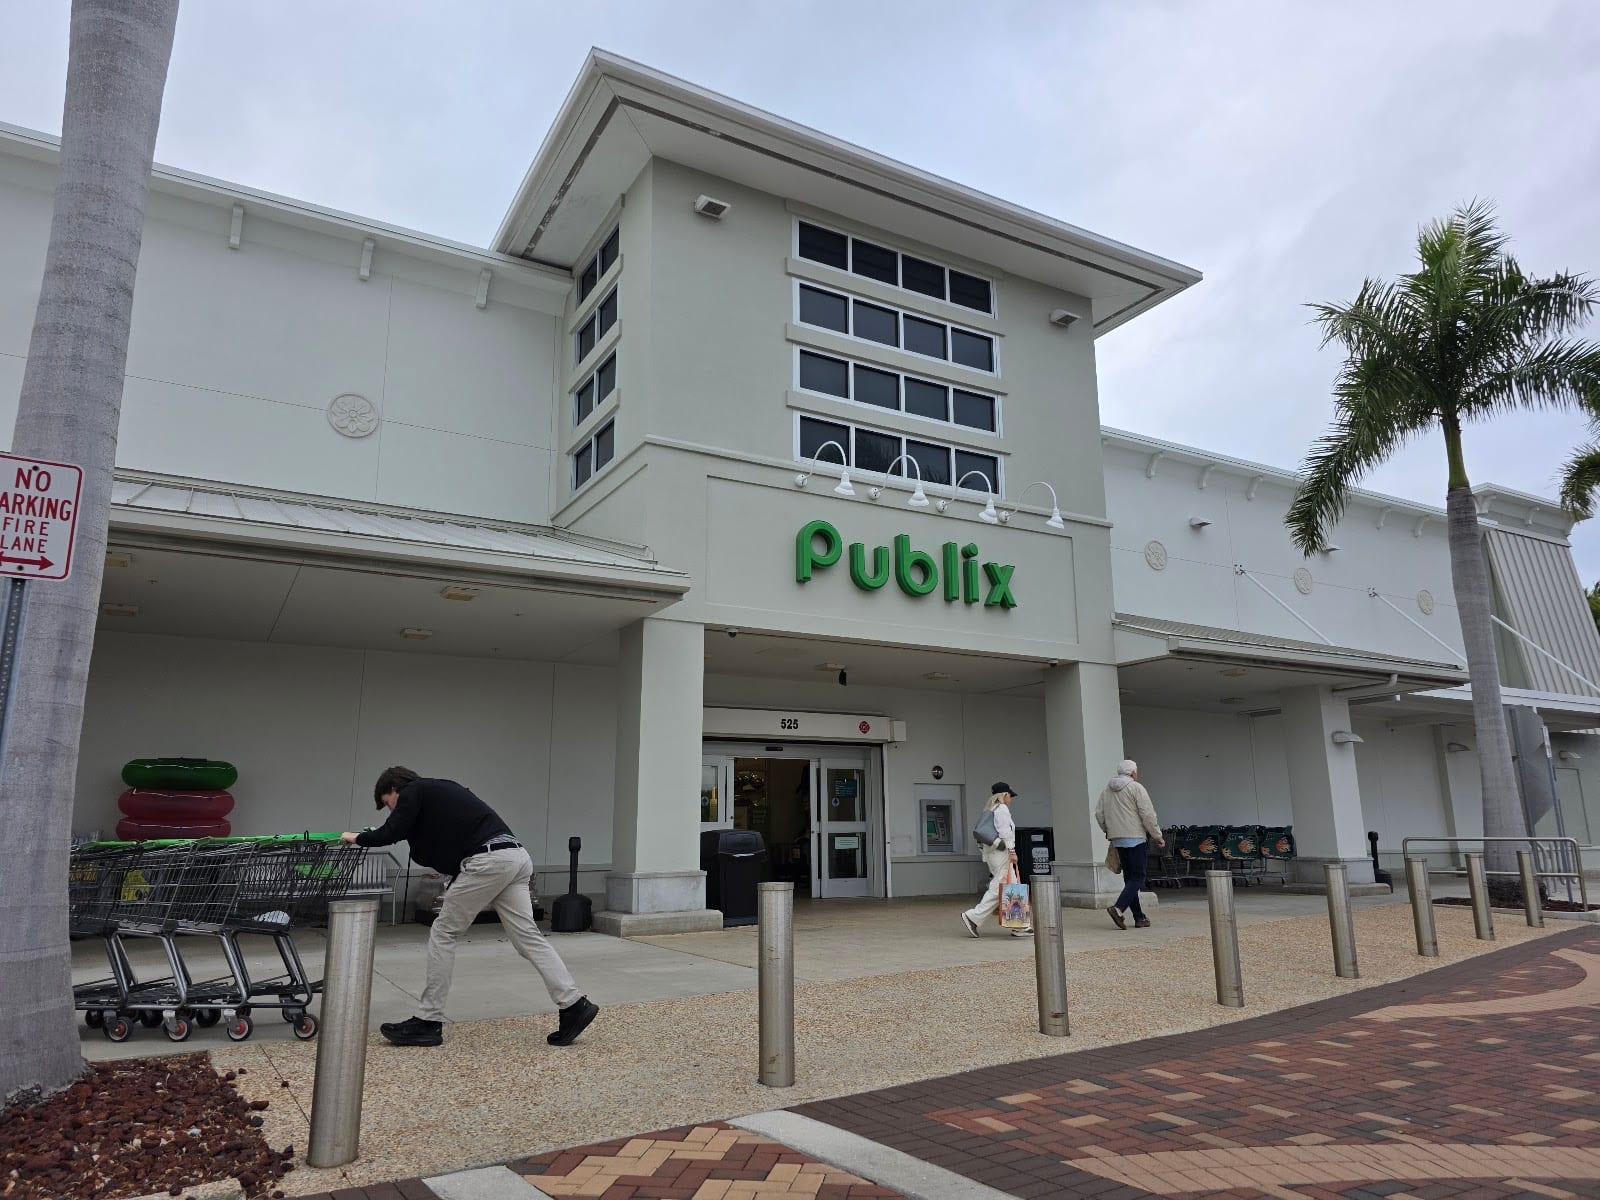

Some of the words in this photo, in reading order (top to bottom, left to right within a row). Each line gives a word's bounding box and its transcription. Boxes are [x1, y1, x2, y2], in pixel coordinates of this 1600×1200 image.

[15, 467, 51, 492] NO
[0, 491, 72, 521] ARKING
[2, 517, 50, 537] FIRE
[0, 534, 48, 554] LANE
[796, 520, 1017, 608] Publix
[780, 718, 799, 730] 525
